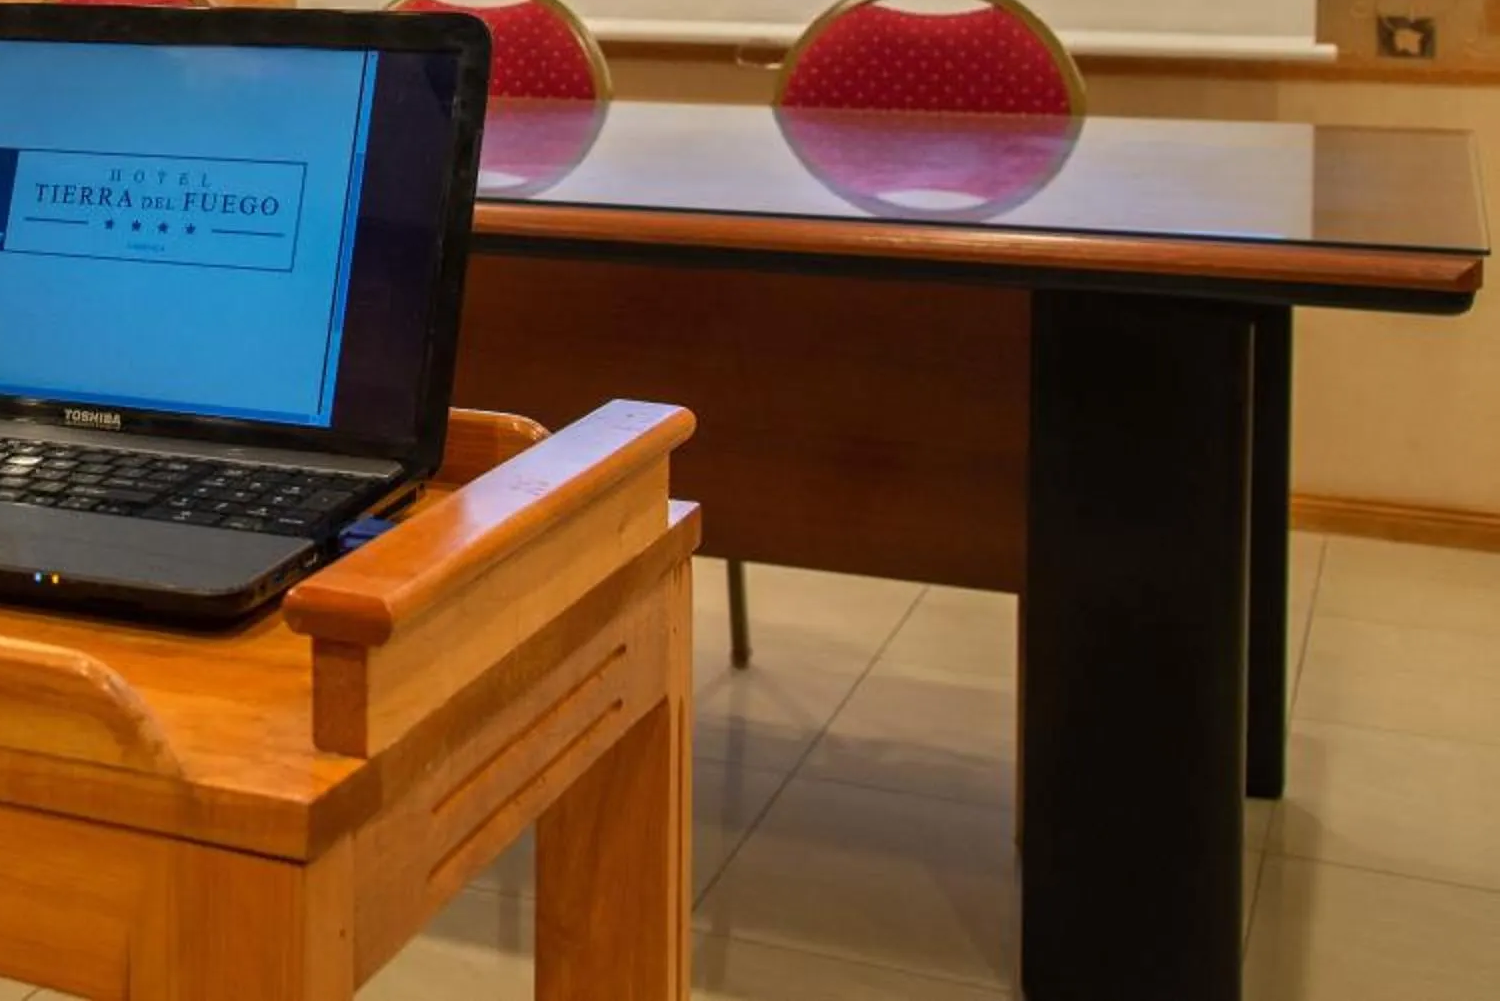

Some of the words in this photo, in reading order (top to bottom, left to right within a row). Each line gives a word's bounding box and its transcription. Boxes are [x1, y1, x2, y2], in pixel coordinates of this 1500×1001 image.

[110, 169, 212, 187] HOTEL
[35, 183, 133, 208] TIERRA
[141, 196, 174, 211] DEL
[182, 192, 280, 216] FUEGO
[64, 409, 121, 424] TOSHIBA
